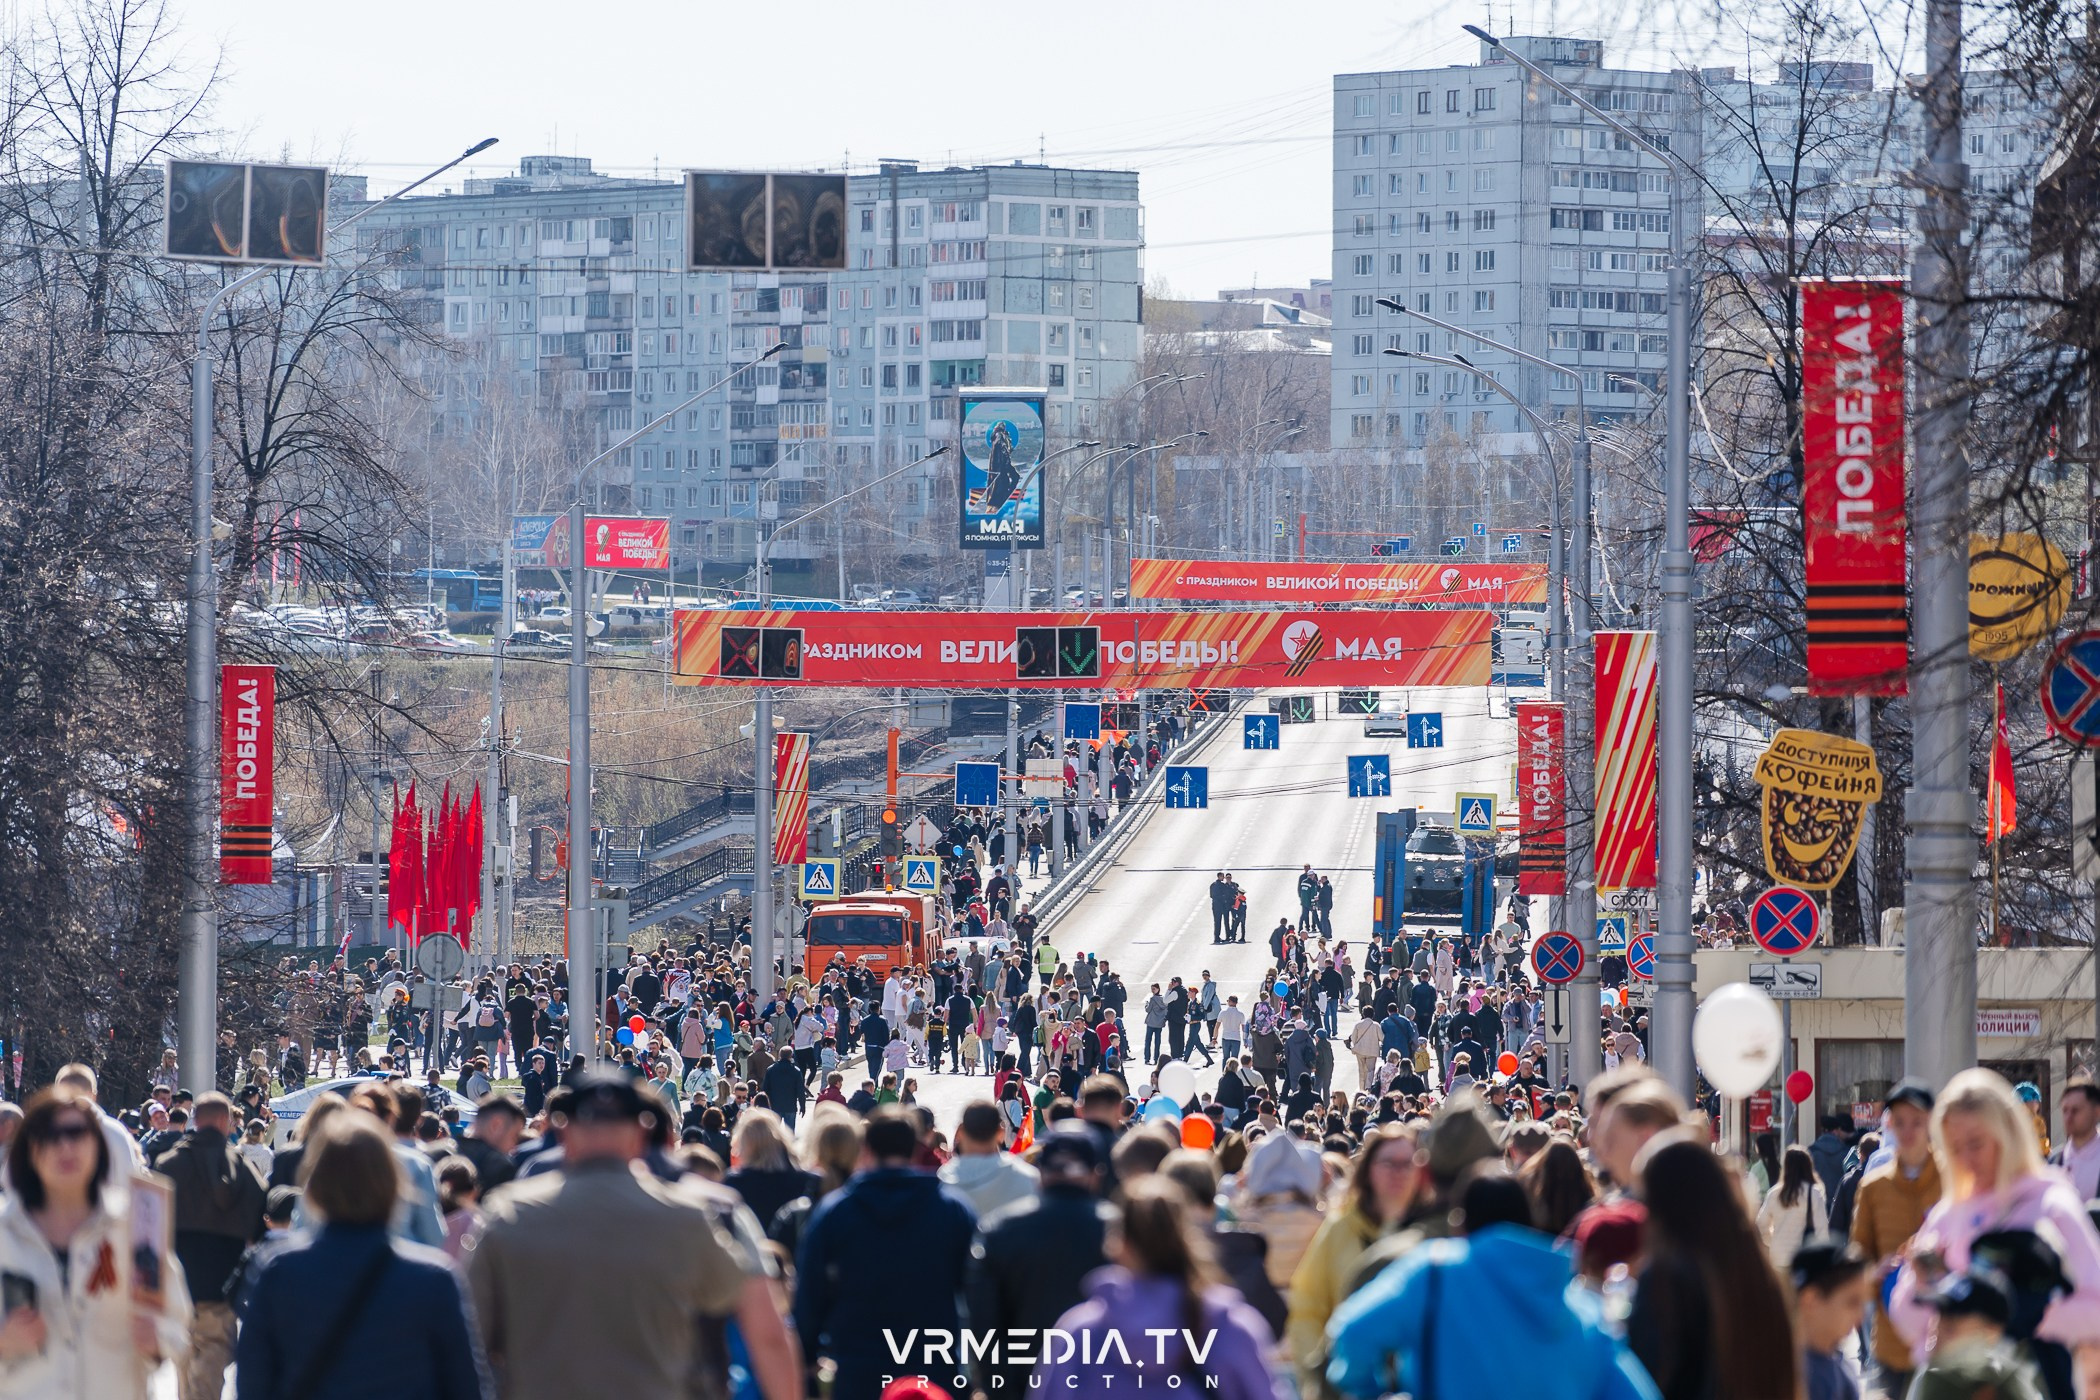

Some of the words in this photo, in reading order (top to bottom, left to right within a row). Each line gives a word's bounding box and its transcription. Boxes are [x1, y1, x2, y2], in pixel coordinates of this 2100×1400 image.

[1834, 303, 1879, 534] ПОБЕДА!
[980, 519, 1024, 534] МАЯ
[618, 536, 653, 548] ВЕЛИКОЙ
[596, 553, 610, 562] МАЯ
[623, 548, 657, 560] ПОБЕДЫ!
[1176, 576, 1184, 585] С
[1186, 576, 1258, 587] ПРАЗДНИКОМ
[1266, 573, 1339, 590] ВЕЛИКОЙ
[1345, 578, 1418, 592] ПОБЕДЫ!
[1468, 577, 1502, 590] МАЯ
[1985, 632, 2008, 641] 1995
[803, 643, 922, 660] РАЗДНИКОМ
[940, 640, 1017, 663] ВЕЛИ
[1100, 640, 1239, 667] ПОБЕДЫ!
[1335, 637, 1401, 661] МАЯ
[236, 679, 261, 799] ПОБЕДА!
[1532, 715, 1553, 820] ПОБЕДА!
[1611, 895, 1647, 907] СТОП
[279, 1111, 304, 1119] КЕМЕР
